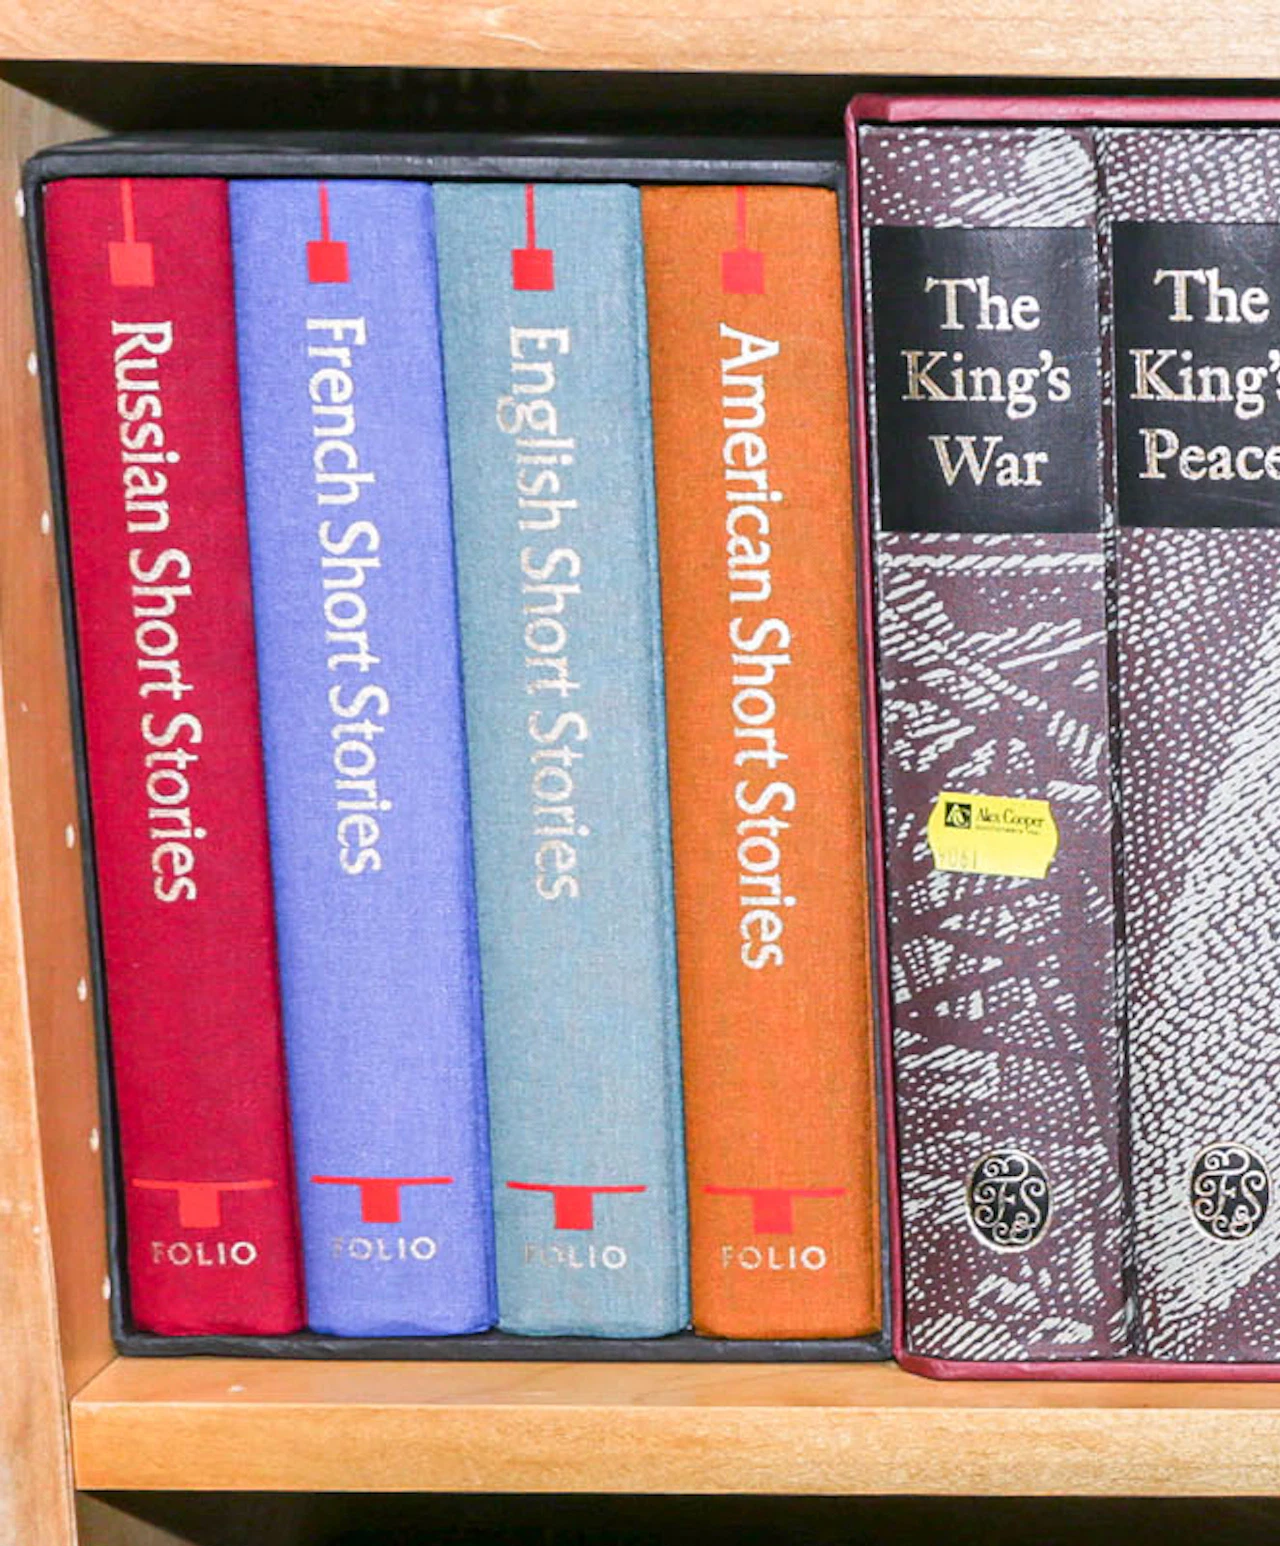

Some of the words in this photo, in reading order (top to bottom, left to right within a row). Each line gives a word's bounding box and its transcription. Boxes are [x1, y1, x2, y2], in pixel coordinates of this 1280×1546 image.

[925, 276, 1041, 331] The
[1153, 268, 1271, 324] The
[111, 320, 172, 534] Russian
[306, 316, 366, 507] French
[497, 326, 577, 531] English
[901, 349, 1072, 420] King's
[719, 323, 783, 605] American
[929, 435, 1049, 487] War
[129, 549, 192, 700] Short
[320, 520, 381, 672] Short
[520, 547, 582, 695] Short
[730, 617, 796, 763] Short
[141, 713, 207, 903] Stories
[329, 684, 389, 875] Stories
[527, 709, 590, 901] Stories
[735, 779, 797, 971] Stories
[152, 1240, 257, 1267] FOLIO
[332, 1236, 437, 1262] FOLIO
[526, 1244, 627, 1271] FOLIO
[722, 1245, 827, 1271] FOLIO
